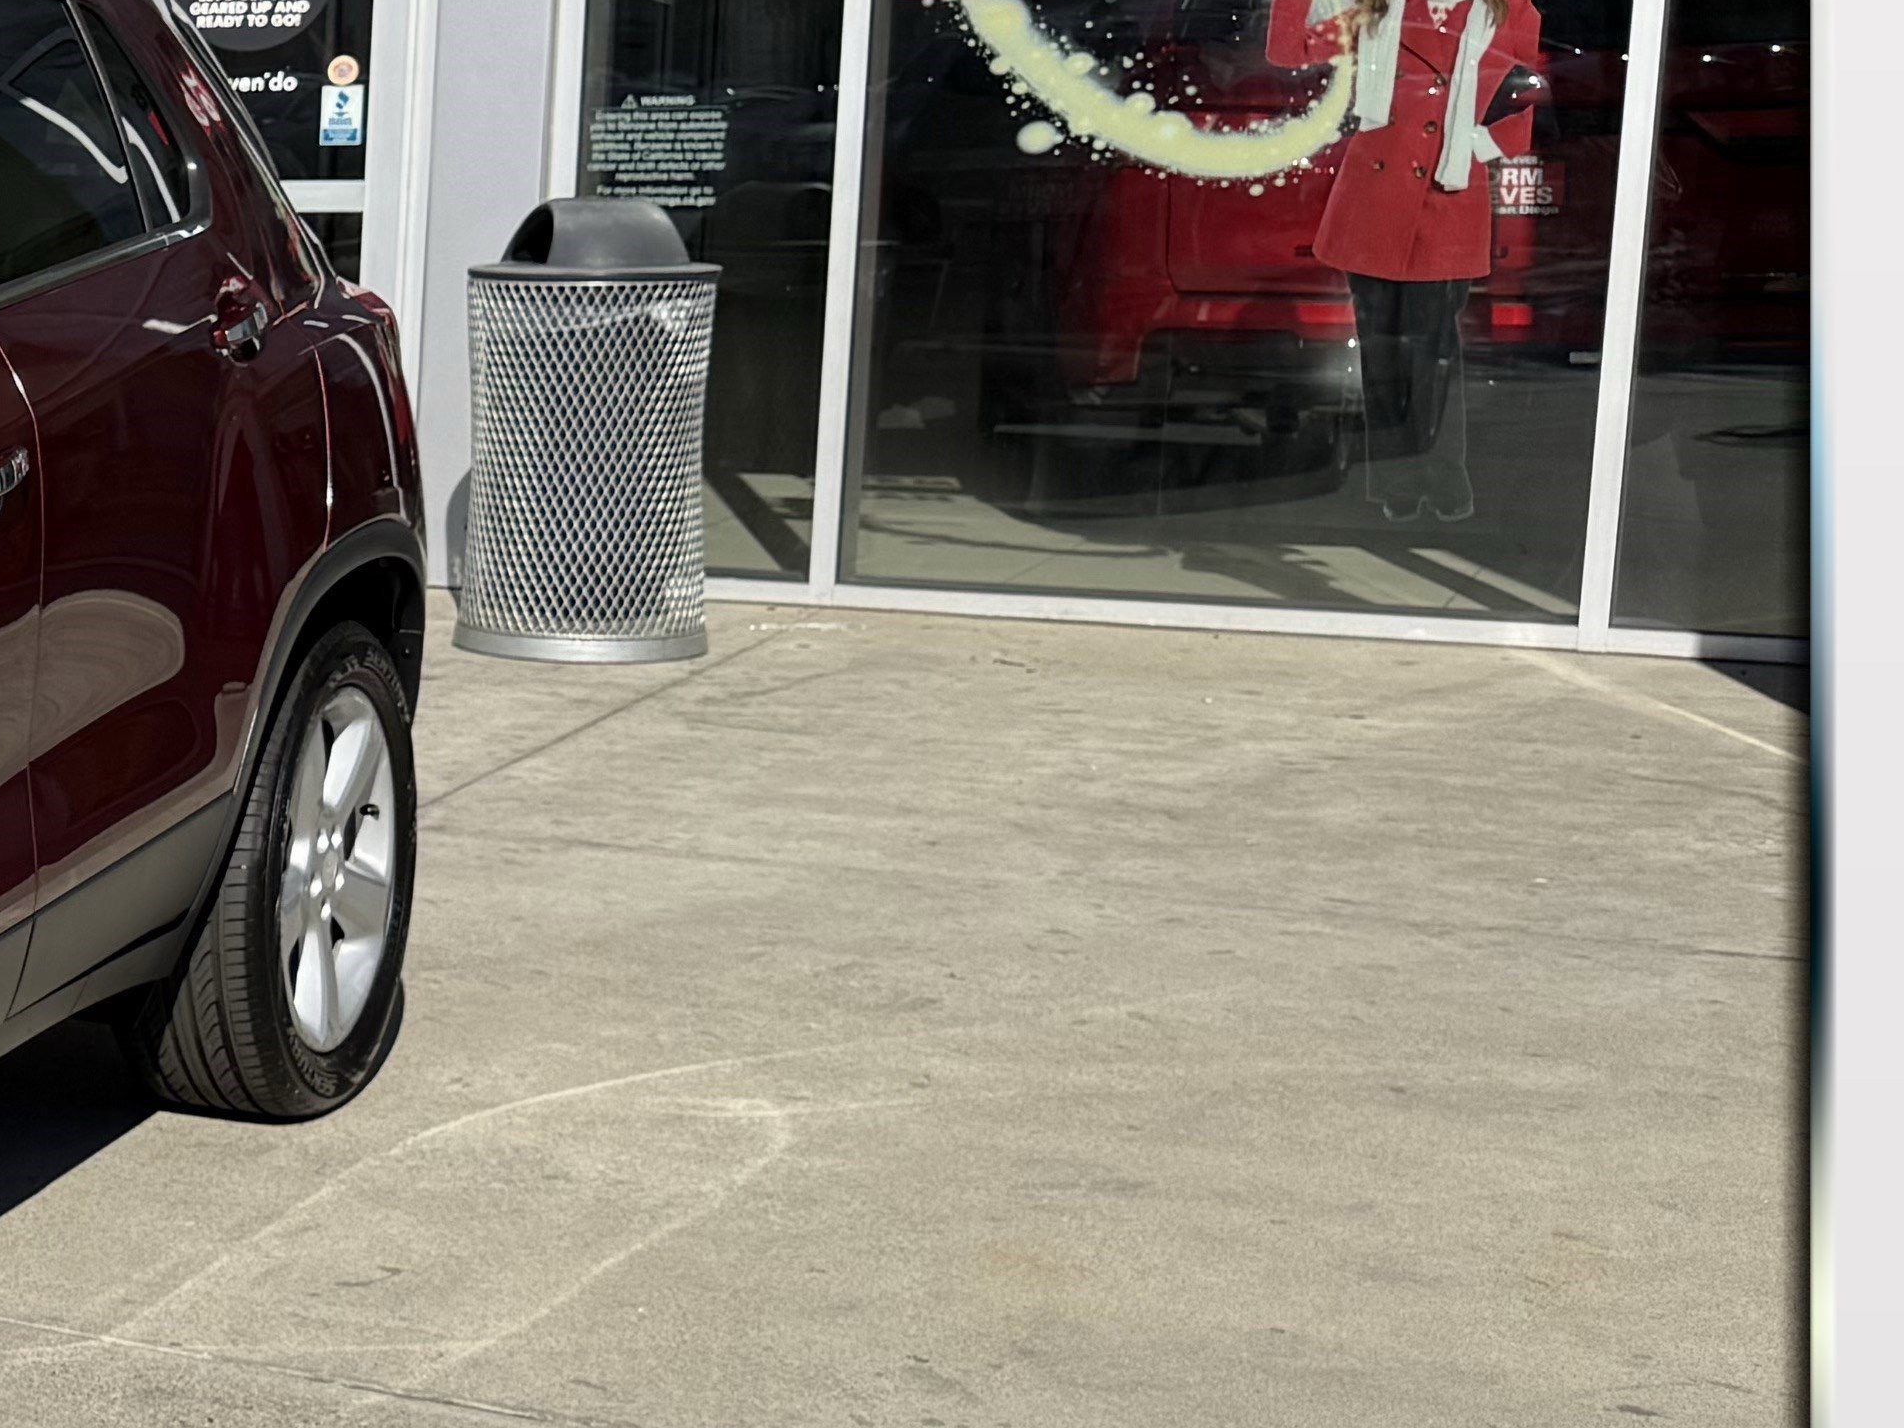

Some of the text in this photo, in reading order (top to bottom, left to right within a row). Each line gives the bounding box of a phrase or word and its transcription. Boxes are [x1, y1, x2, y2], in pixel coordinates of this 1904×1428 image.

[189, 0, 310, 15] GEARED UP AND
[196, 14, 302, 28] READY TO GO!
[640, 95, 695, 106] WARNING
